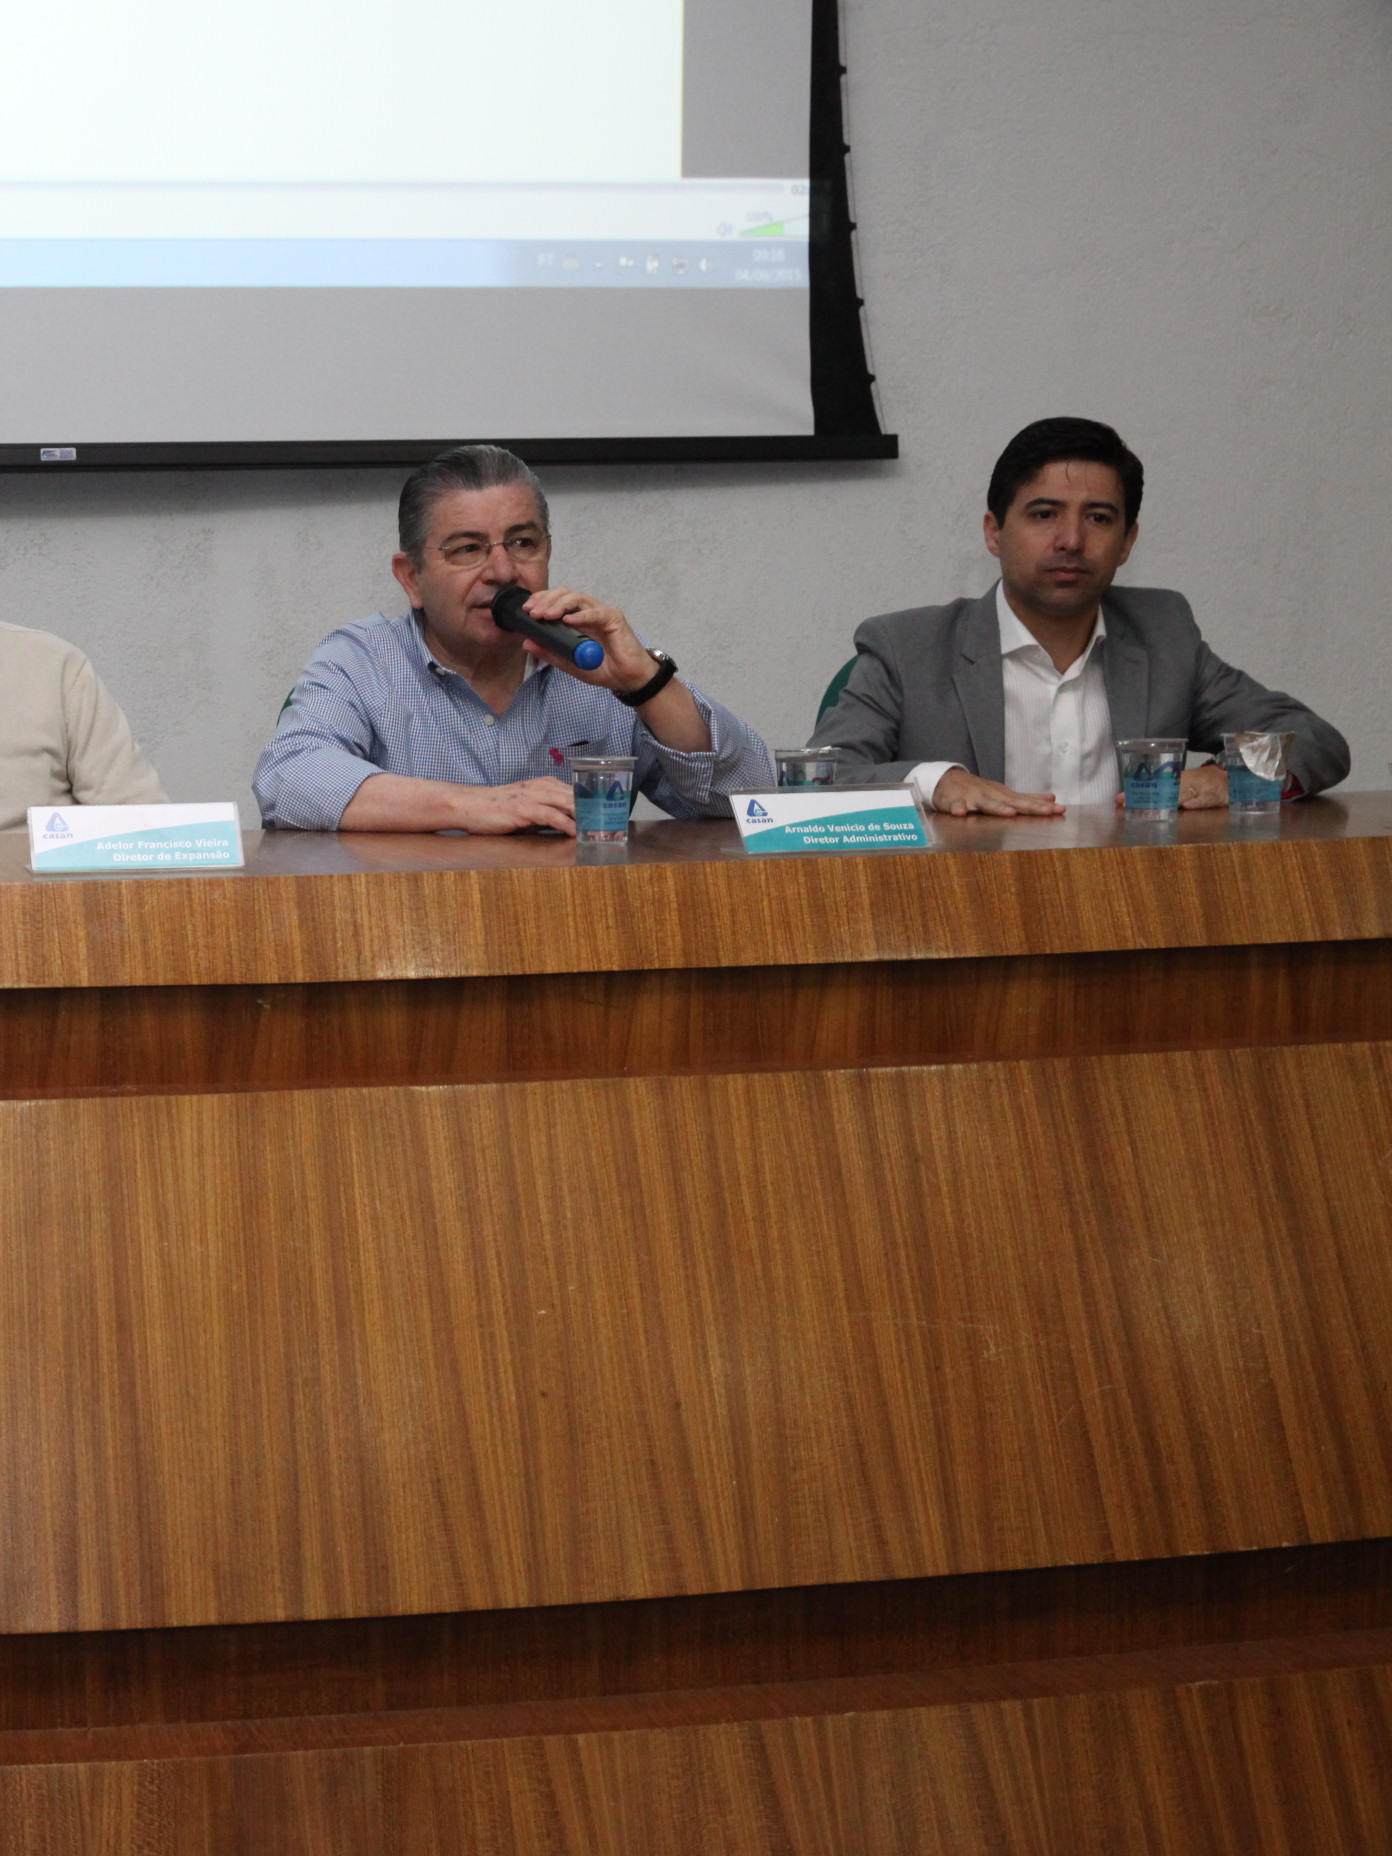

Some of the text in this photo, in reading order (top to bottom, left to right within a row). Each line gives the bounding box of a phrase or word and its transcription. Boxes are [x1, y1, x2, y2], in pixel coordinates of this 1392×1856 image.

[602, 801, 627, 809] casan
[746, 816, 774, 825] casan
[784, 824, 826, 834] Arnaldo
[868, 822, 882, 832] de
[883, 821, 915, 831] Souza
[43, 832, 74, 840] casan
[803, 833, 918, 845] Diretor Administrativo
[97, 838, 229, 851] Adelor Francisco Vieira
[113, 850, 230, 862] Diretor de Expansão
